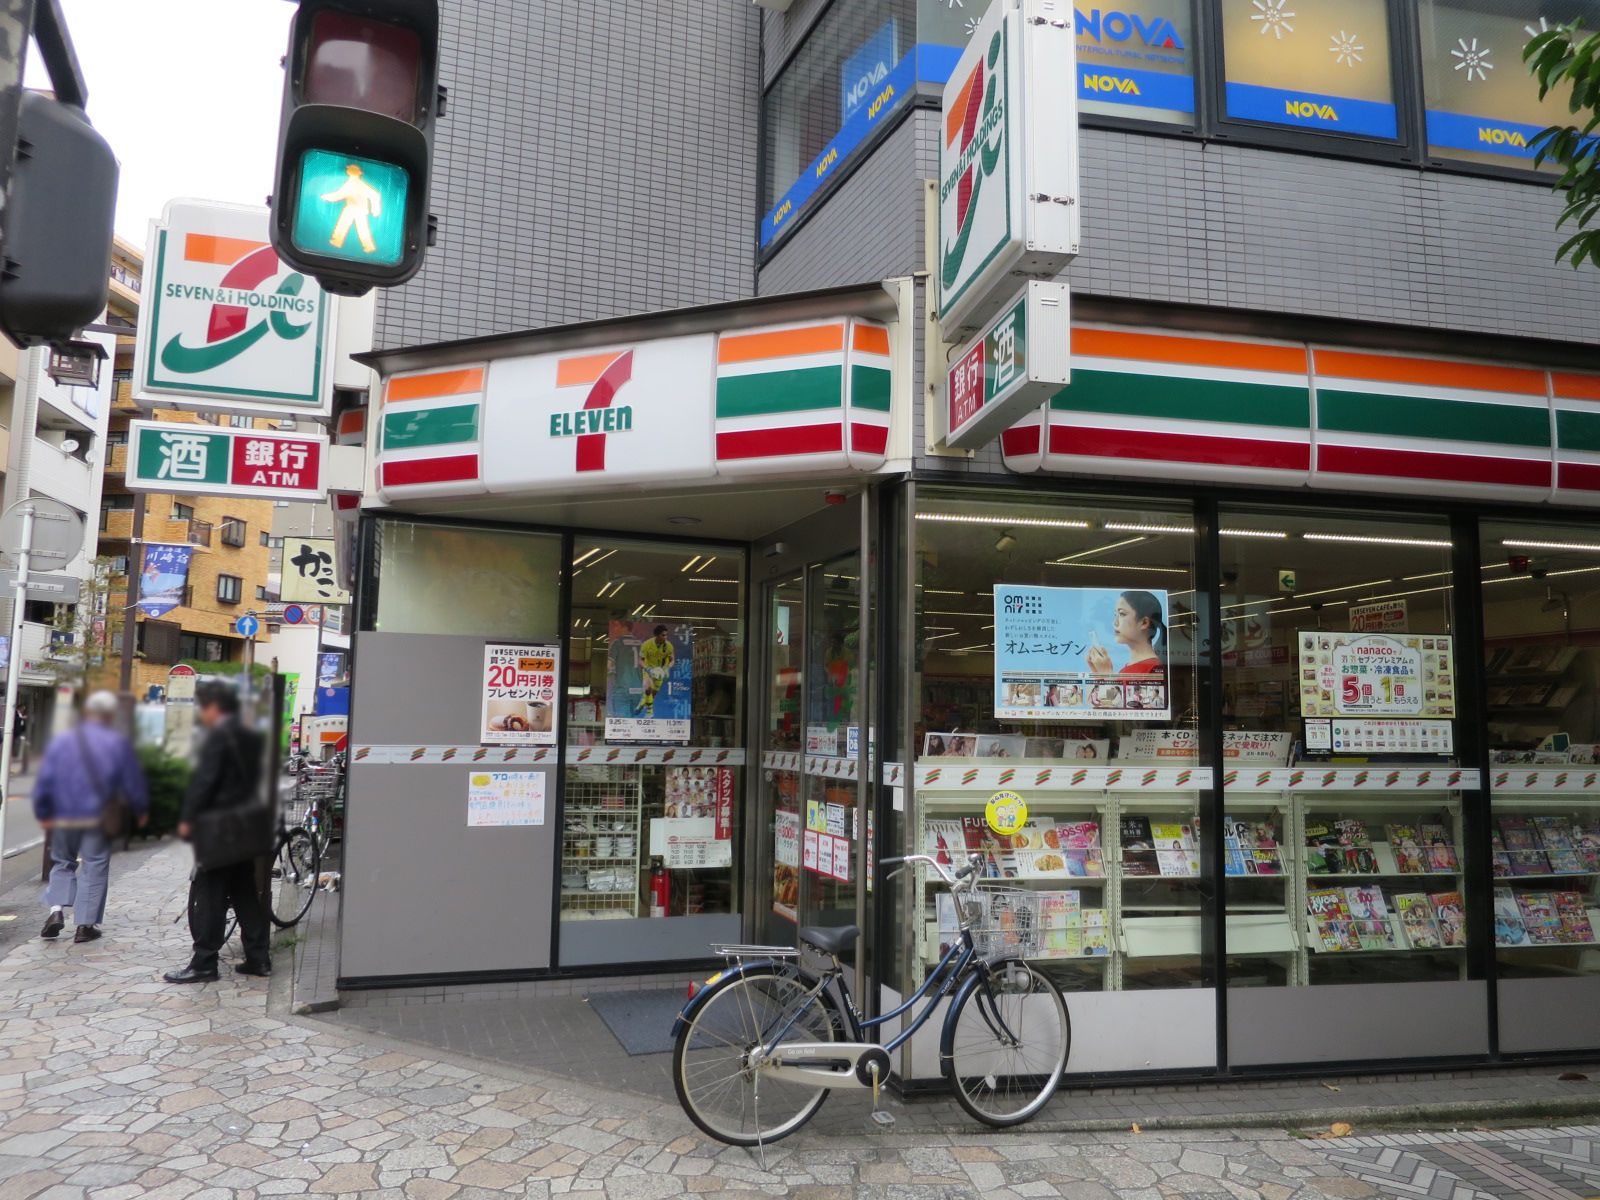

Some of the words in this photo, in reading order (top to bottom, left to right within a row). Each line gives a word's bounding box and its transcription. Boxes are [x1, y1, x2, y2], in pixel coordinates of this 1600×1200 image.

[1074, 8, 1185, 50] NOVA
[846, 60, 890, 109] NOVA
[1083, 74, 1141, 95] NOVA
[868, 84, 895, 121] NOVA
[1285, 100, 1338, 121] NOVA
[967, 98, 1003, 162] HOLDINGS
[1479, 127, 1527, 148] NOVA
[816, 147, 837, 179] NOVA
[773, 199, 791, 227] NOVA
[237, 292, 315, 313] HOLDINGS
[993, 311, 1016, 395] 酒
[955, 351, 979, 402] 銀行
[957, 393, 976, 423] ATM
[156, 433, 210, 480] 酒
[244, 440, 309, 470] 銀行
[251, 470, 300, 487] ATM
[1005, 640, 1088, 656] オムニセブン
[1357, 647, 1393, 655] nanaco
[488, 665, 554, 687] 20円引券
[520, 660, 553, 669] ドーナツ
[488, 688, 540, 699] プレゼント!
[1342, 675, 1360, 704] 5
[1380, 676, 1392, 704] 1
[1362, 696, 1382, 705] 買うと
[1394, 696, 1419, 705] もらえる
[964, 817, 990, 828] FUD
